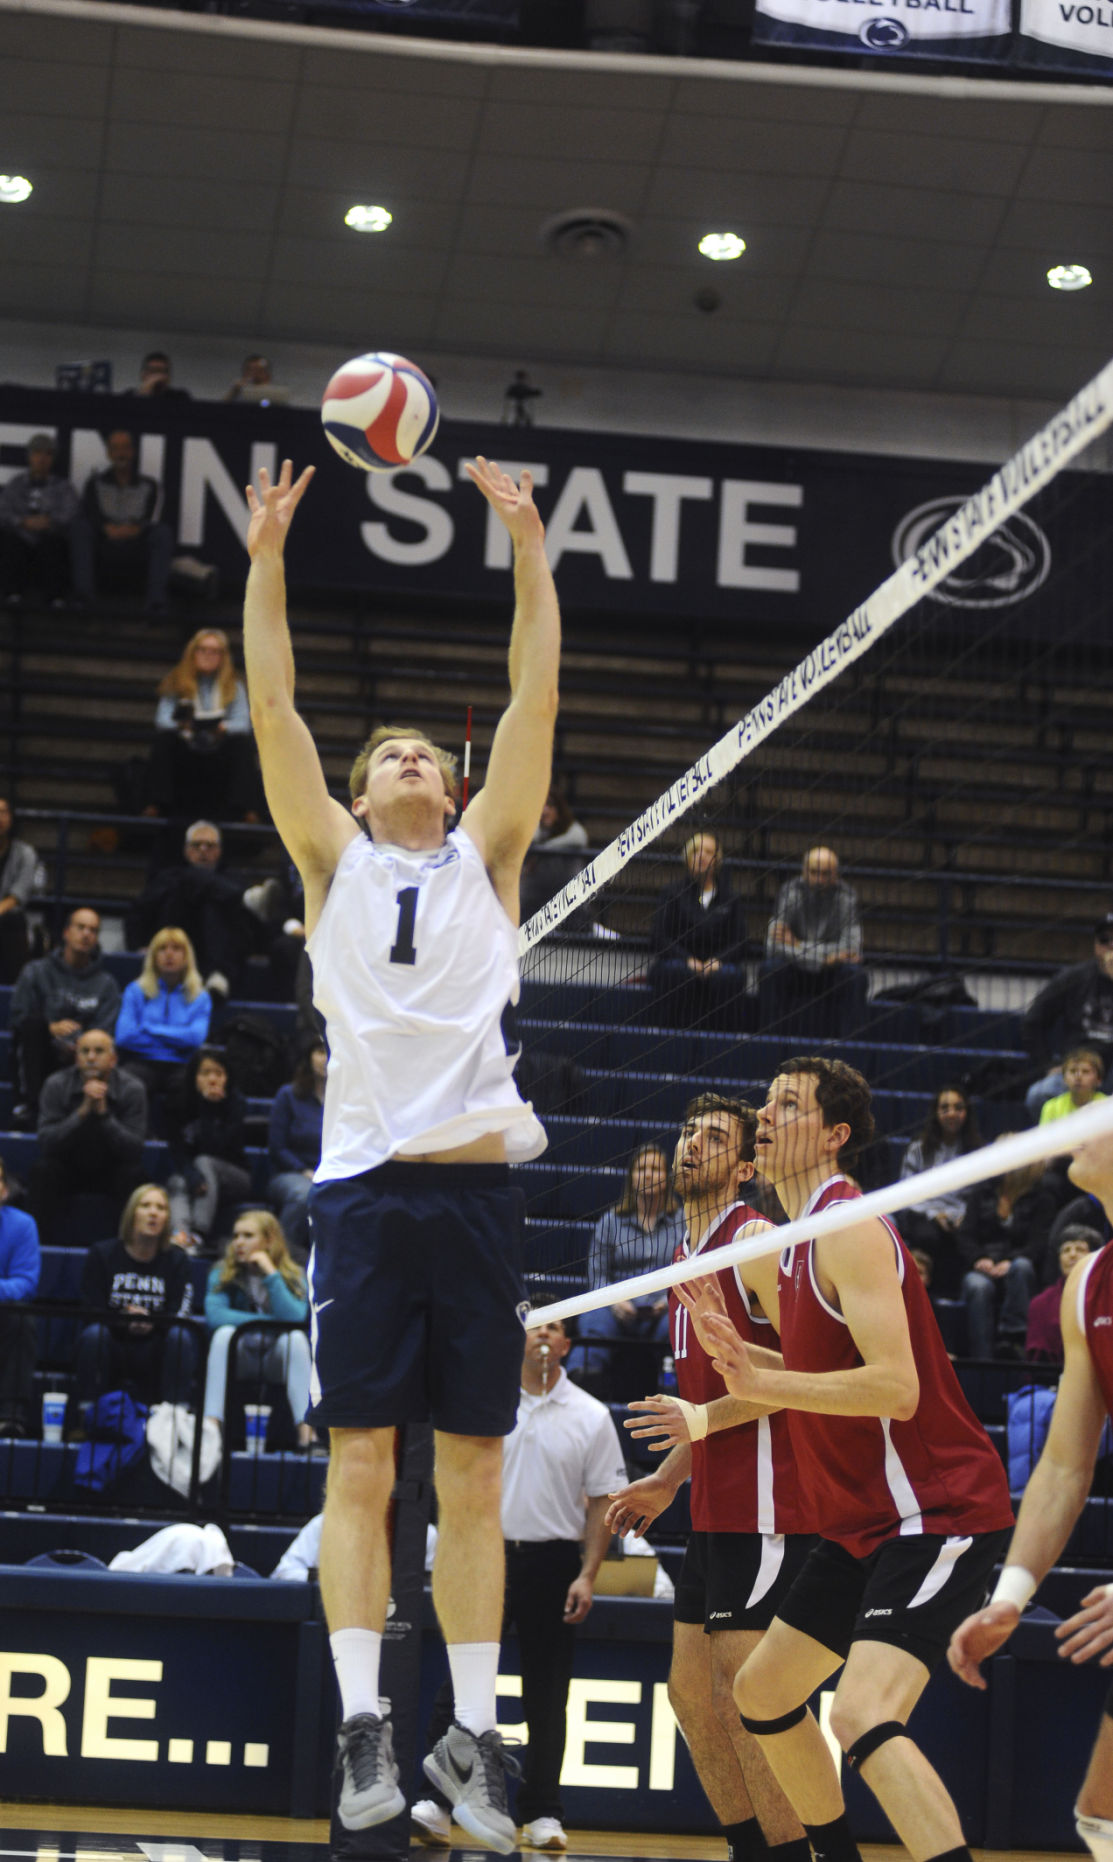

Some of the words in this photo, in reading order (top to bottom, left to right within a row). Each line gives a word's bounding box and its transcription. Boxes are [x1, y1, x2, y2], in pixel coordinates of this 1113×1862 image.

[1059, 4, 1113, 28] VOL
[360, 453, 803, 593] STATE
[389, 886, 419, 965] 1
[112, 1272, 165, 1294] PENN
[674, 1303, 688, 1360] 11
